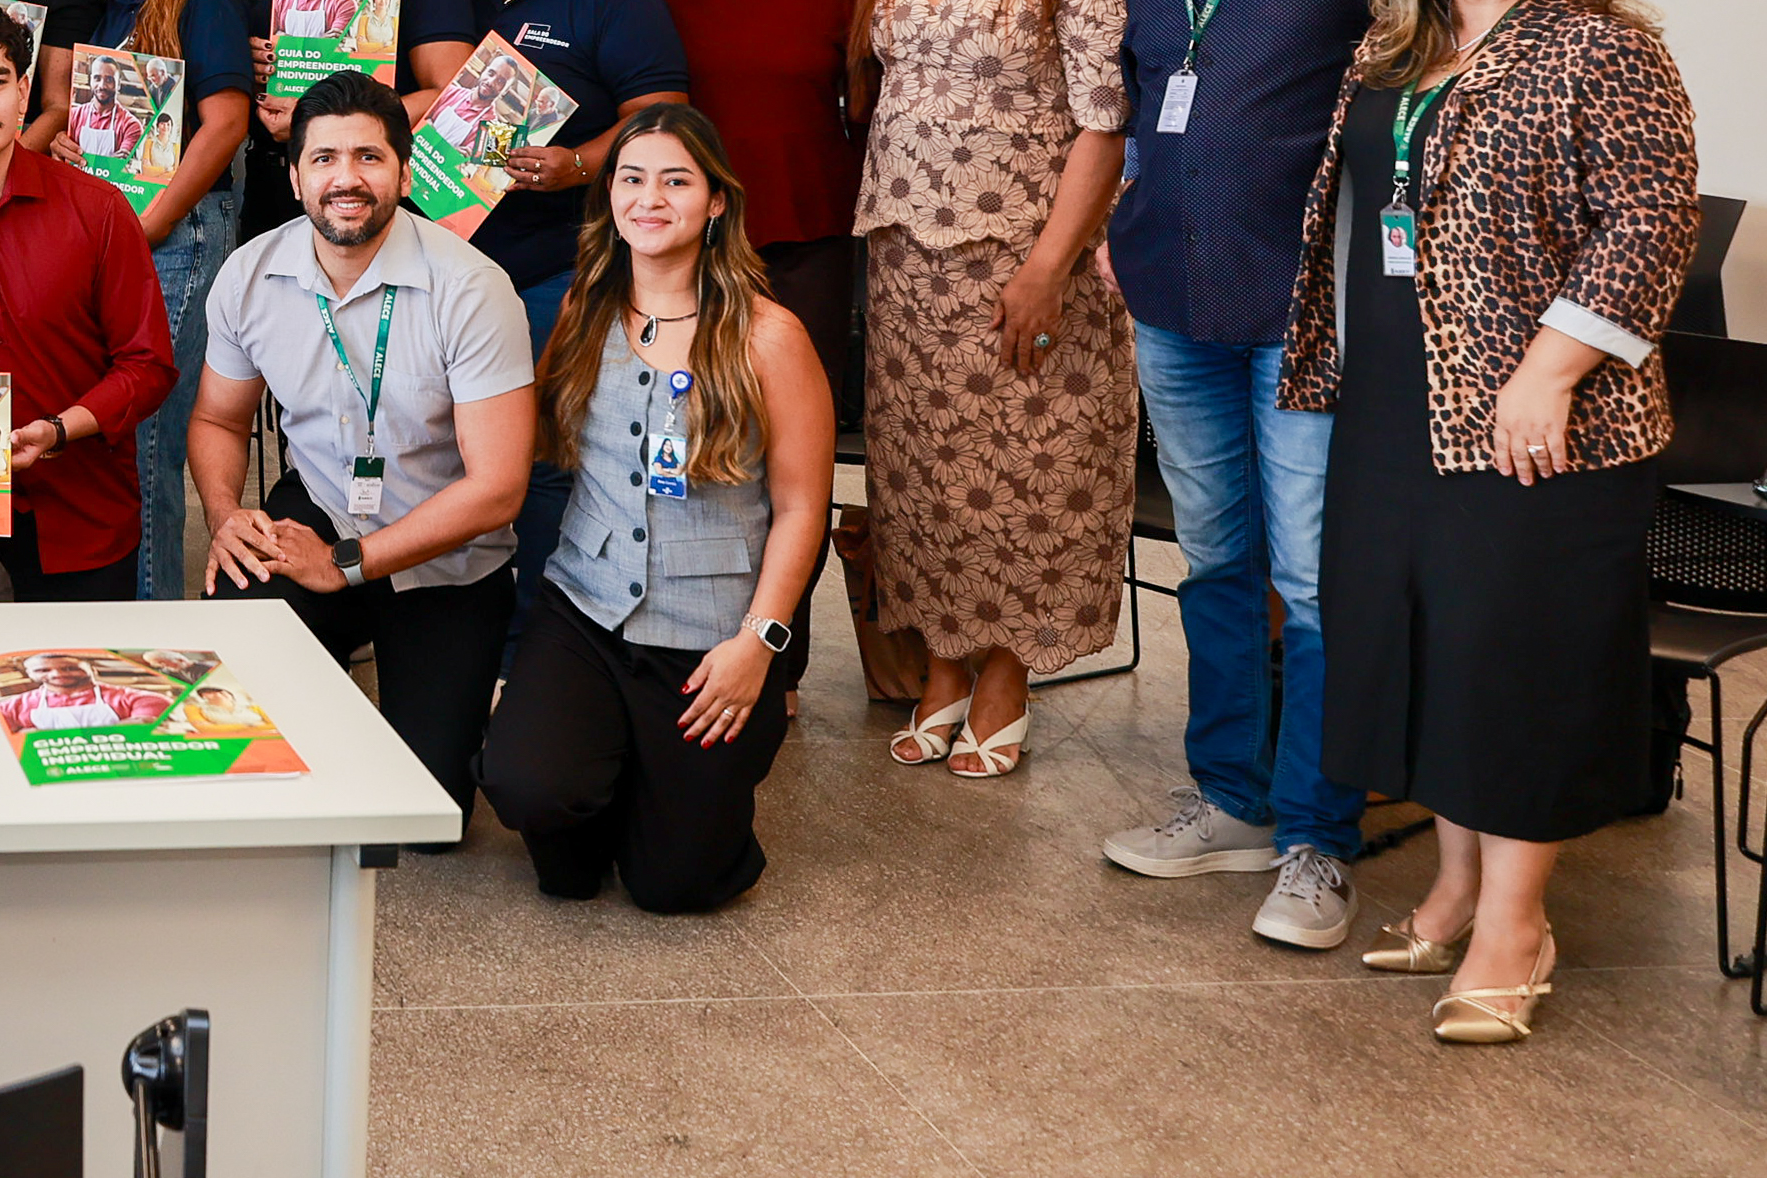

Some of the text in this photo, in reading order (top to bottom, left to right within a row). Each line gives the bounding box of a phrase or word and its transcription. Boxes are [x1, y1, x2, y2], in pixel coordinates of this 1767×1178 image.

[1199, 3, 1214, 29] ALECE
[278, 49, 321, 59] GUIA DO
[277, 70, 330, 82] INDIVIDUA
[284, 85, 305, 93] ALECE
[1397, 97, 1410, 121] ALECE
[1403, 116, 1419, 143] ALECE
[415, 134, 445, 164] GUIA DO
[95, 168, 110, 178] DO
[408, 157, 442, 193] DIVIDUAL
[382, 293, 393, 321] ALECE
[321, 307, 335, 334] ALECE
[373, 351, 384, 379] ALECE
[33, 734, 126, 749] GUIA DO
[37, 741, 220, 758] EMPREENDEDOR
[41, 751, 173, 766] INDIVIDUAL
[65, 764, 110, 775] ALECE
